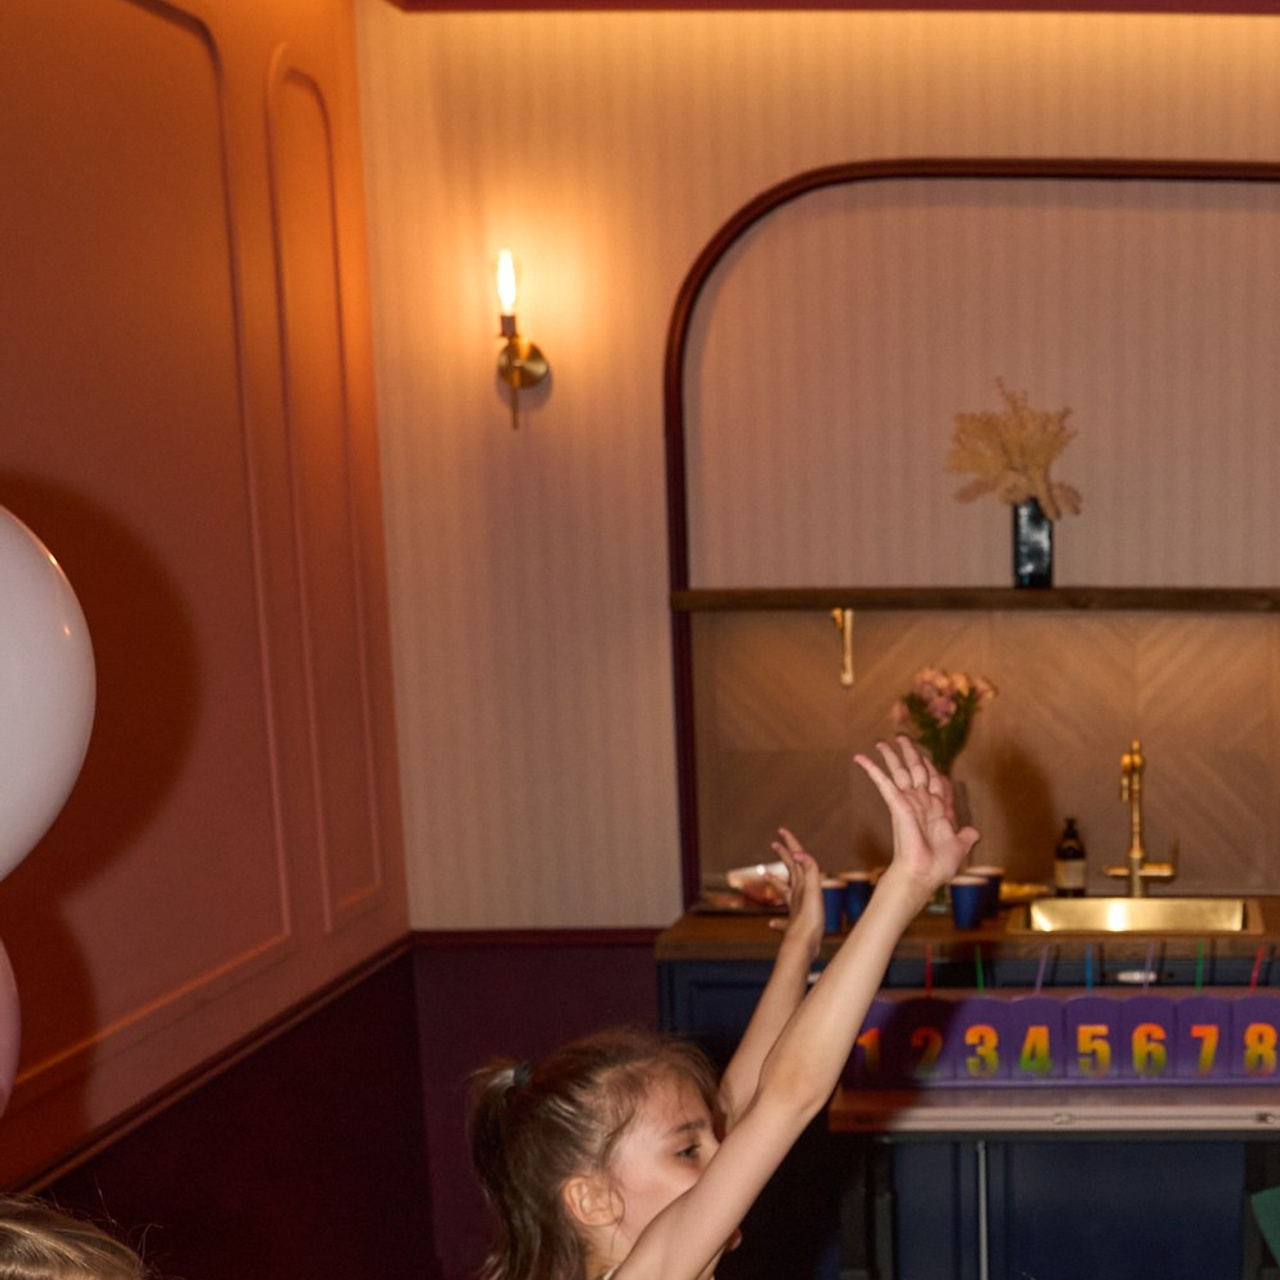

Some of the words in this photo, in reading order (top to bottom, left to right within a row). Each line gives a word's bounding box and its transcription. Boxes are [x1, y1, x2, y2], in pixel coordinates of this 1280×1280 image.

[910, 1026, 944, 1078] 2
[964, 1025, 999, 1078] 3
[1018, 1025, 1053, 1077] 4
[1076, 1024, 1111, 1077] 5
[1131, 1023, 1167, 1077] 6
[1190, 1024, 1220, 1077] 7
[1243, 1023, 1279, 1077] 8
